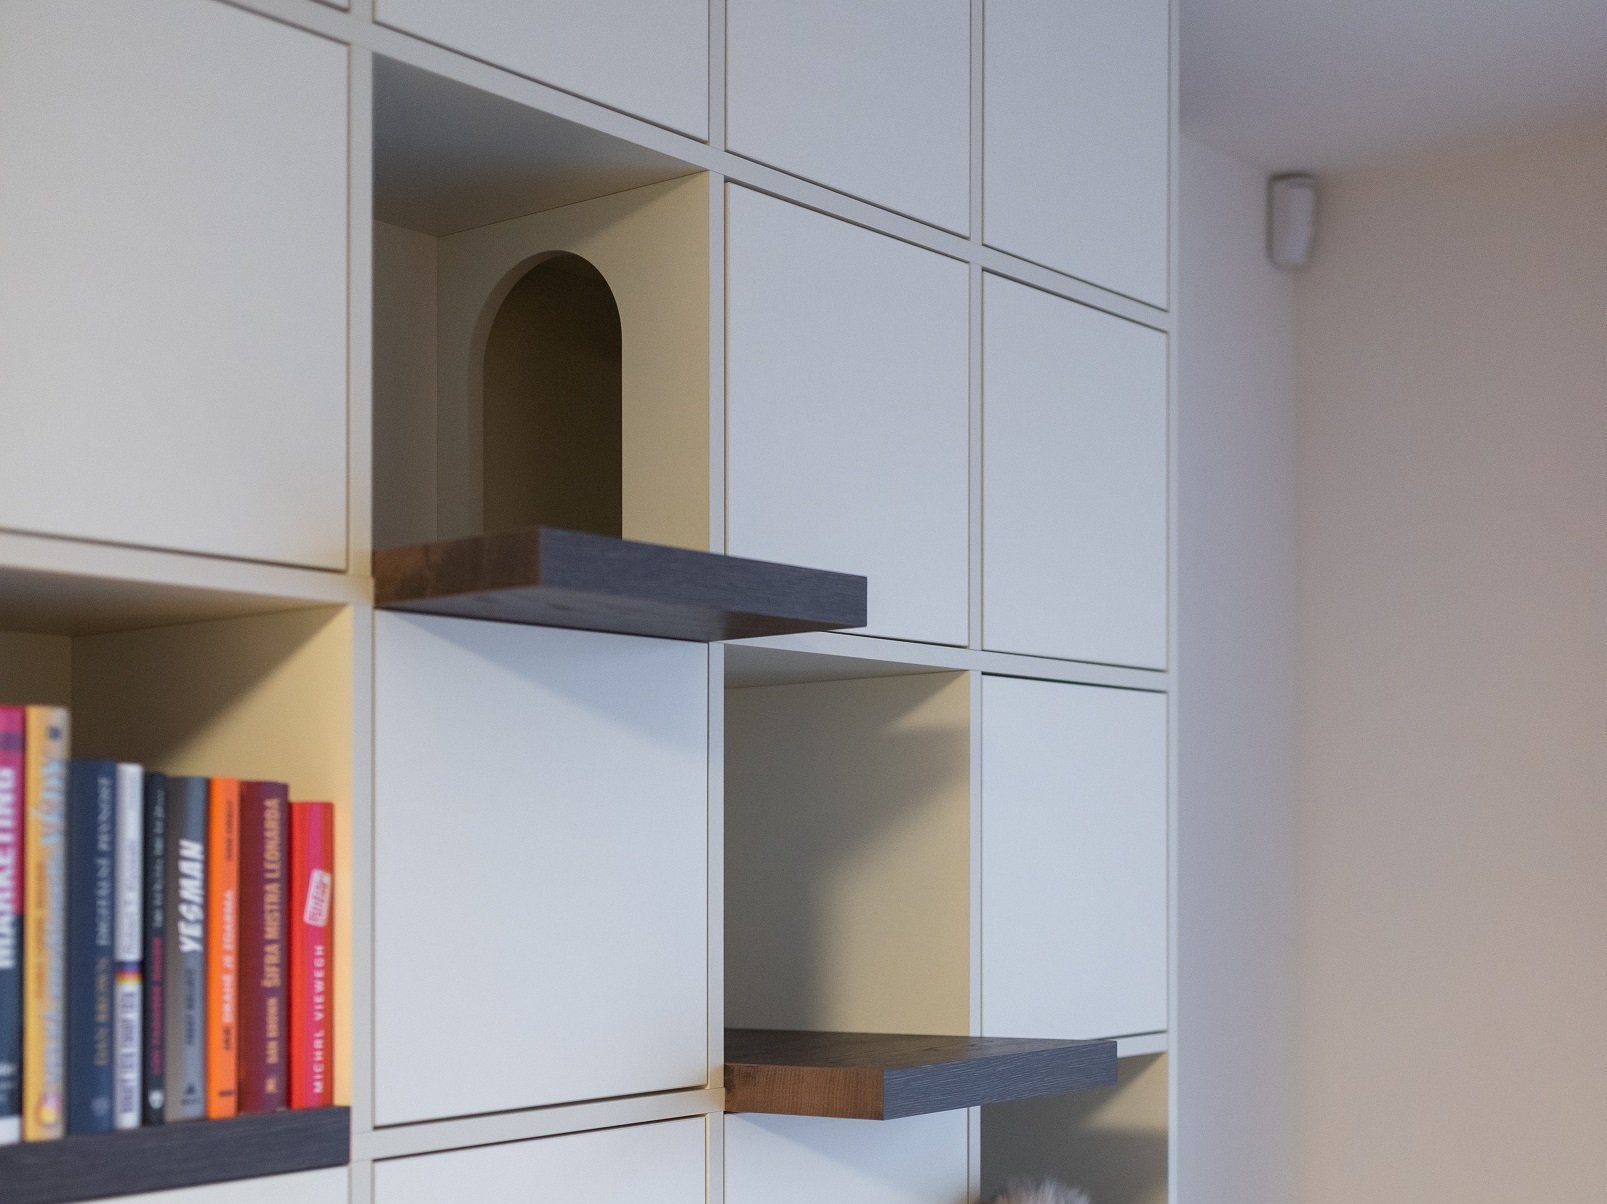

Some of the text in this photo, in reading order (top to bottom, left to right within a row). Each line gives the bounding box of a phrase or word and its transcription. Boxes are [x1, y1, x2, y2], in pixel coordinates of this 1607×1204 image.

[178, 839, 204, 953] YESMAN
[261, 797, 281, 988] ŠIFRA MISTRA LEONARDA
[313, 944, 326, 1021] VIEWEGH
